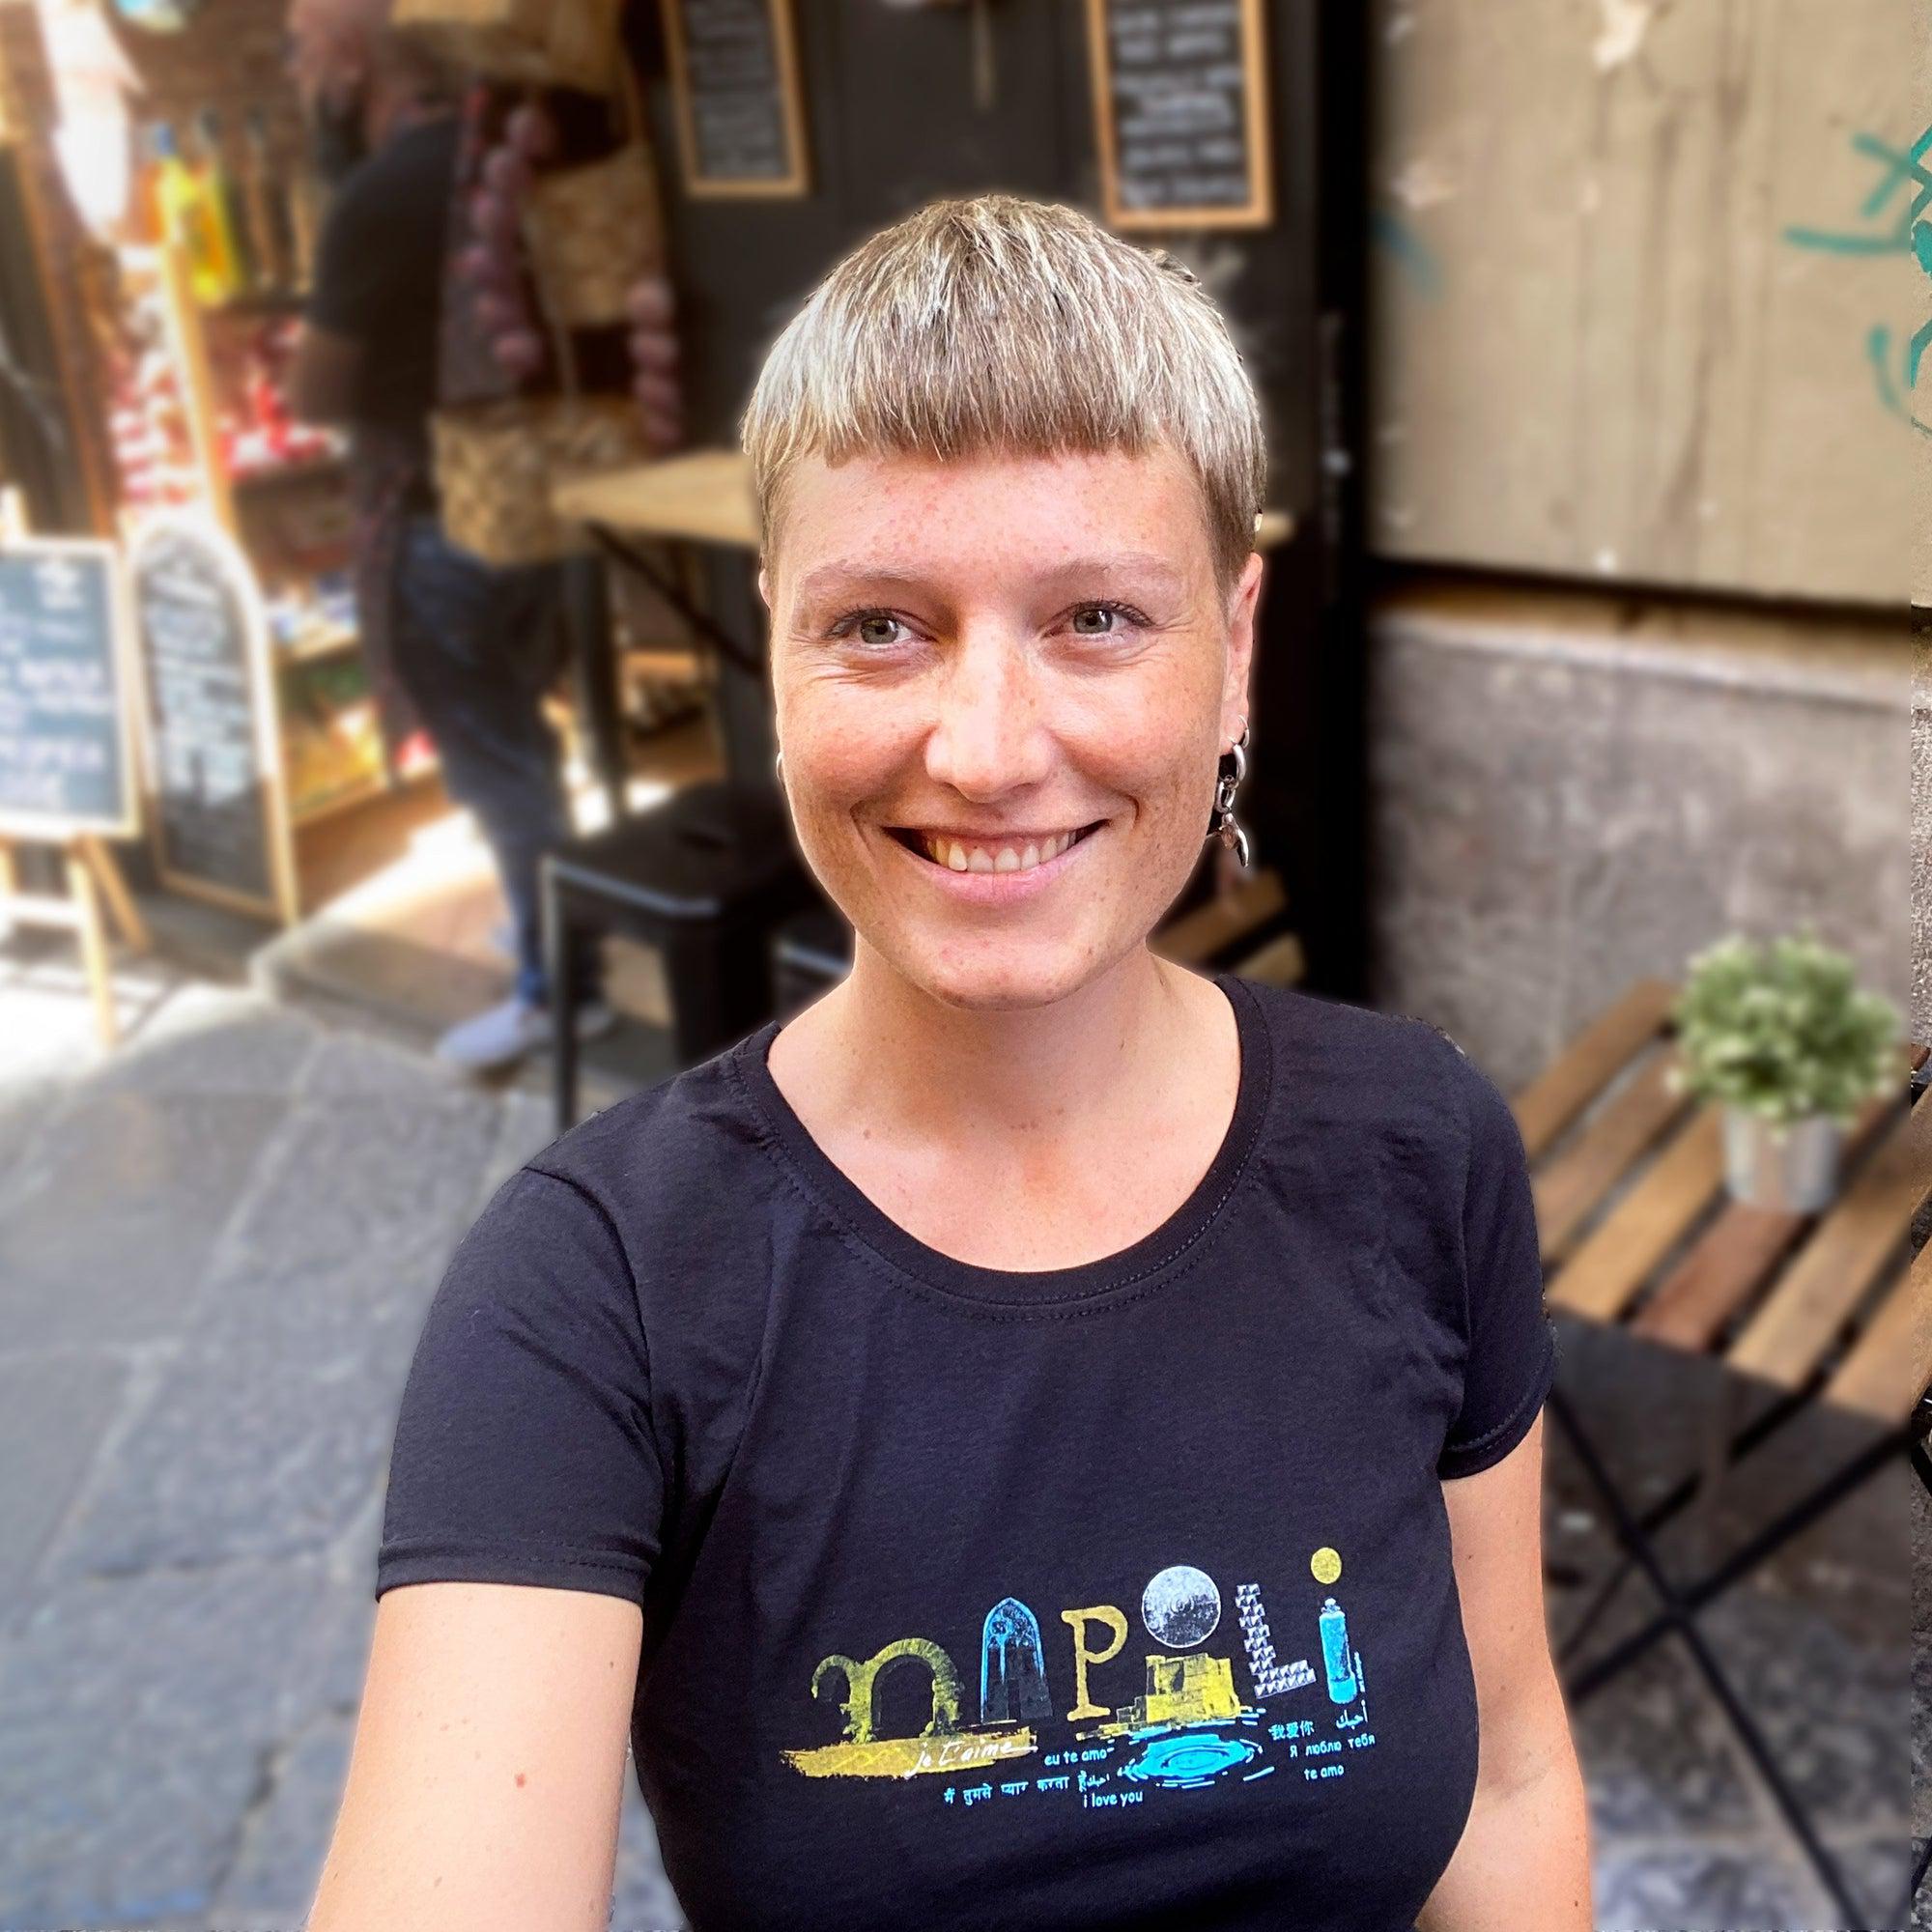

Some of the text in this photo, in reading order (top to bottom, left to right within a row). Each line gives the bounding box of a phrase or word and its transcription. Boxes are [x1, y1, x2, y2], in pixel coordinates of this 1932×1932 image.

[1290, 1733, 1376, 1758] Я люблю тебя
[901, 1742, 932, 1780] je
[1044, 1749, 1108, 1766] eu te amo
[1304, 1765, 1345, 1780] te amo
[963, 1783, 992, 1805] तुमसे
[1001, 1781, 1029, 1796] प्यार
[1037, 1776, 1070, 1792] करता
[1083, 1791, 1144, 1808] i love you
